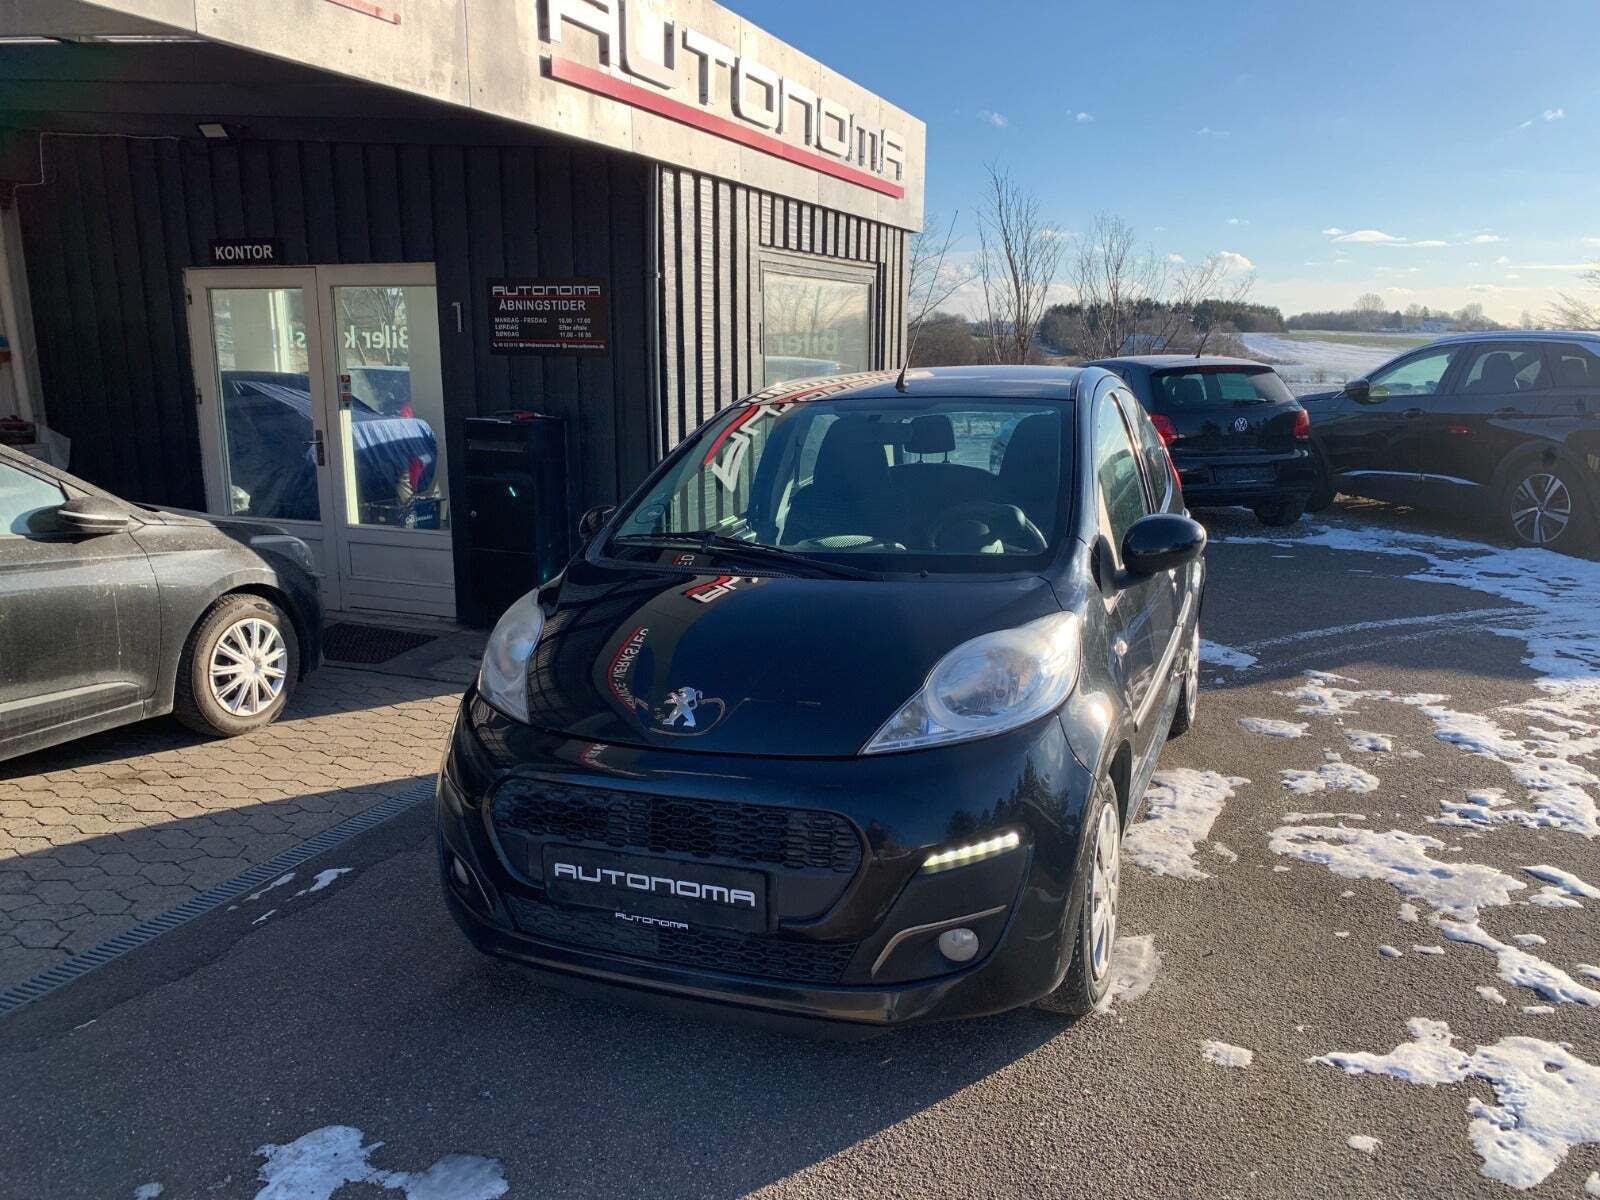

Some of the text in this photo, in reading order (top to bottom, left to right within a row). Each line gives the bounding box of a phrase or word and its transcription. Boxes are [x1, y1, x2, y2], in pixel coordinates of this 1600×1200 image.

[215, 244, 273, 260] KONTOR
[492, 285, 601, 296] AUTONOMA
[499, 298, 586, 311] ÅBNINGSTIDER
[554, 862, 756, 907] AUTONOMA
[615, 912, 689, 930] AUTONOMA
